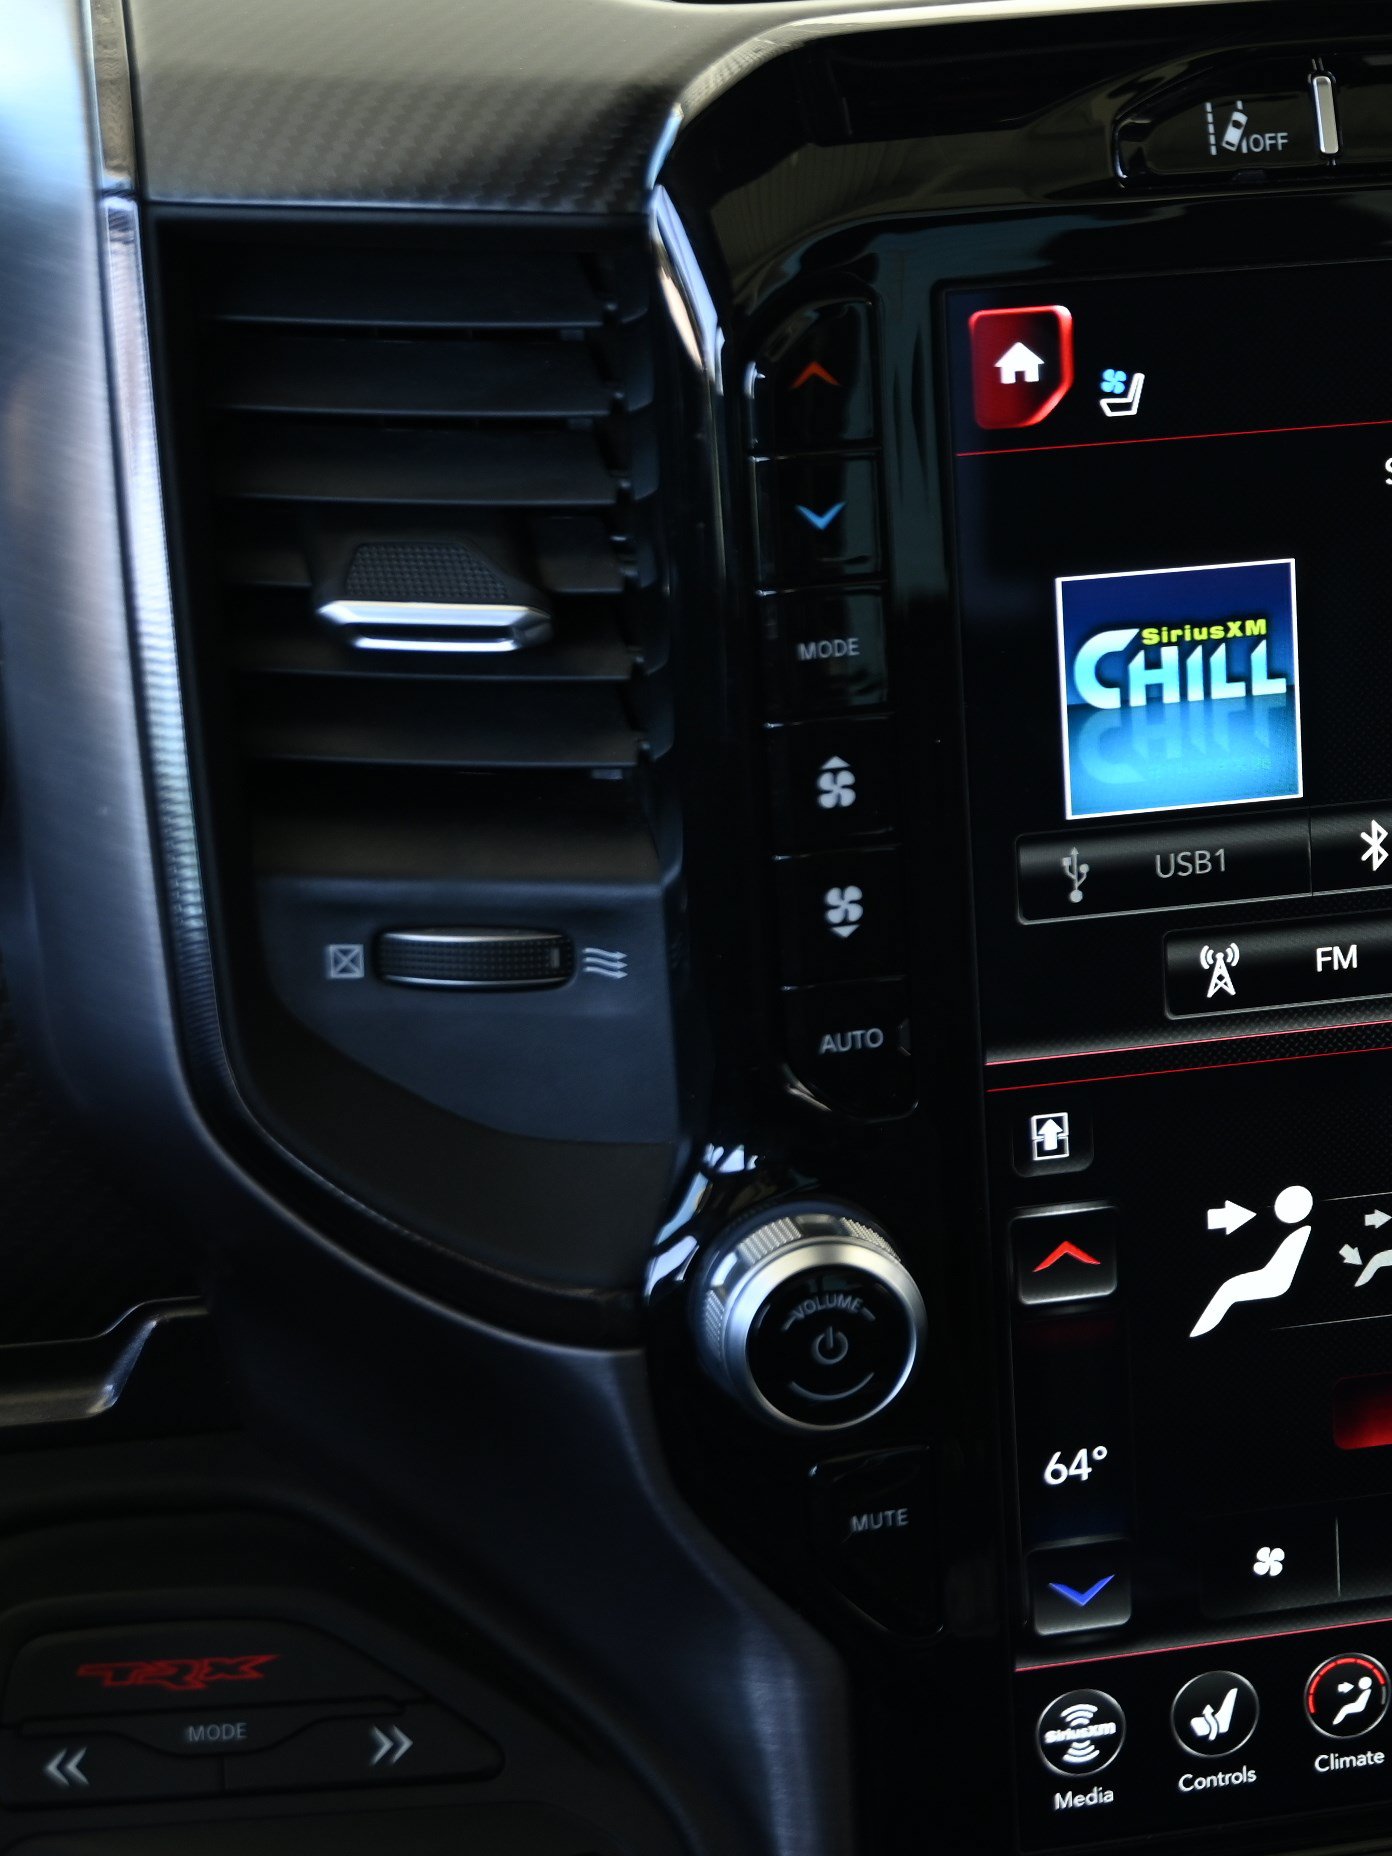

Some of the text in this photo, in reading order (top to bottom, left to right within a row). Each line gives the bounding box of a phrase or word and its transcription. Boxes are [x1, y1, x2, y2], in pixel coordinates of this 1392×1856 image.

[1248, 132, 1289, 153] OFF
[1141, 618, 1267, 645] SiriusXM
[797, 636, 861, 661] MODE
[1074, 628, 1287, 709] CHILL
[1154, 848, 1228, 879] USB1
[1315, 943, 1358, 973] FM
[819, 1027, 884, 1054] AUTO
[793, 1294, 862, 1319] VOLUME
[850, 1508, 909, 1532] MUTE
[187, 1722, 247, 1742] MODE
[1314, 1750, 1386, 1773] Climate
[1178, 1764, 1257, 1792] Controls
[1054, 1786, 1114, 1811] Media
